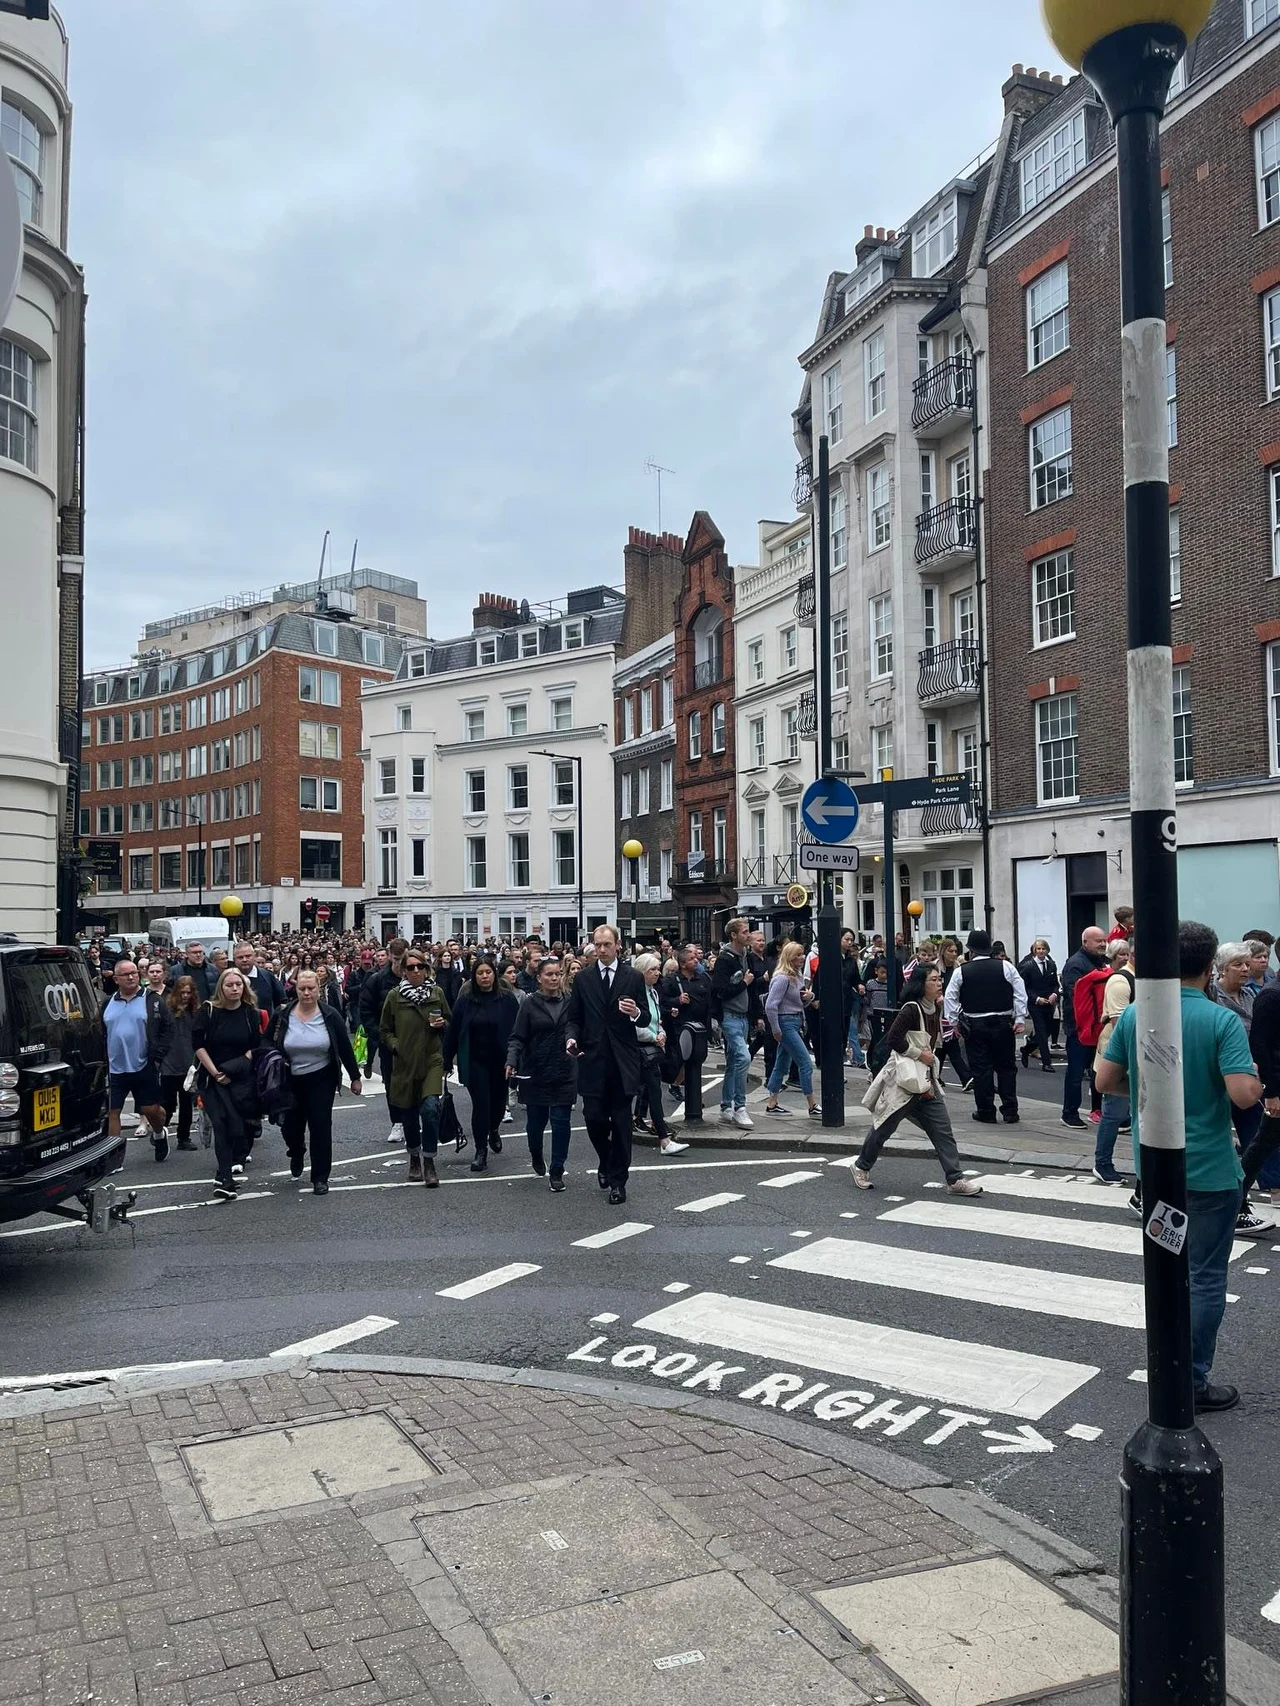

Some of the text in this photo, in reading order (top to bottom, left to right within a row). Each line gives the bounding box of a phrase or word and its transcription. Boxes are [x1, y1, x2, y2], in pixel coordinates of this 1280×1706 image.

[806, 850, 854, 866] One way
[38, 1087, 57, 1107] OU15
[40, 1107, 56, 1126] MXD
[1158, 1206, 1172, 1222] I
[1160, 1234, 1181, 1250] DIER
[1163, 1227, 1184, 1242] ERIC
[567, 1336, 992, 1446] LOOK RIGHT
